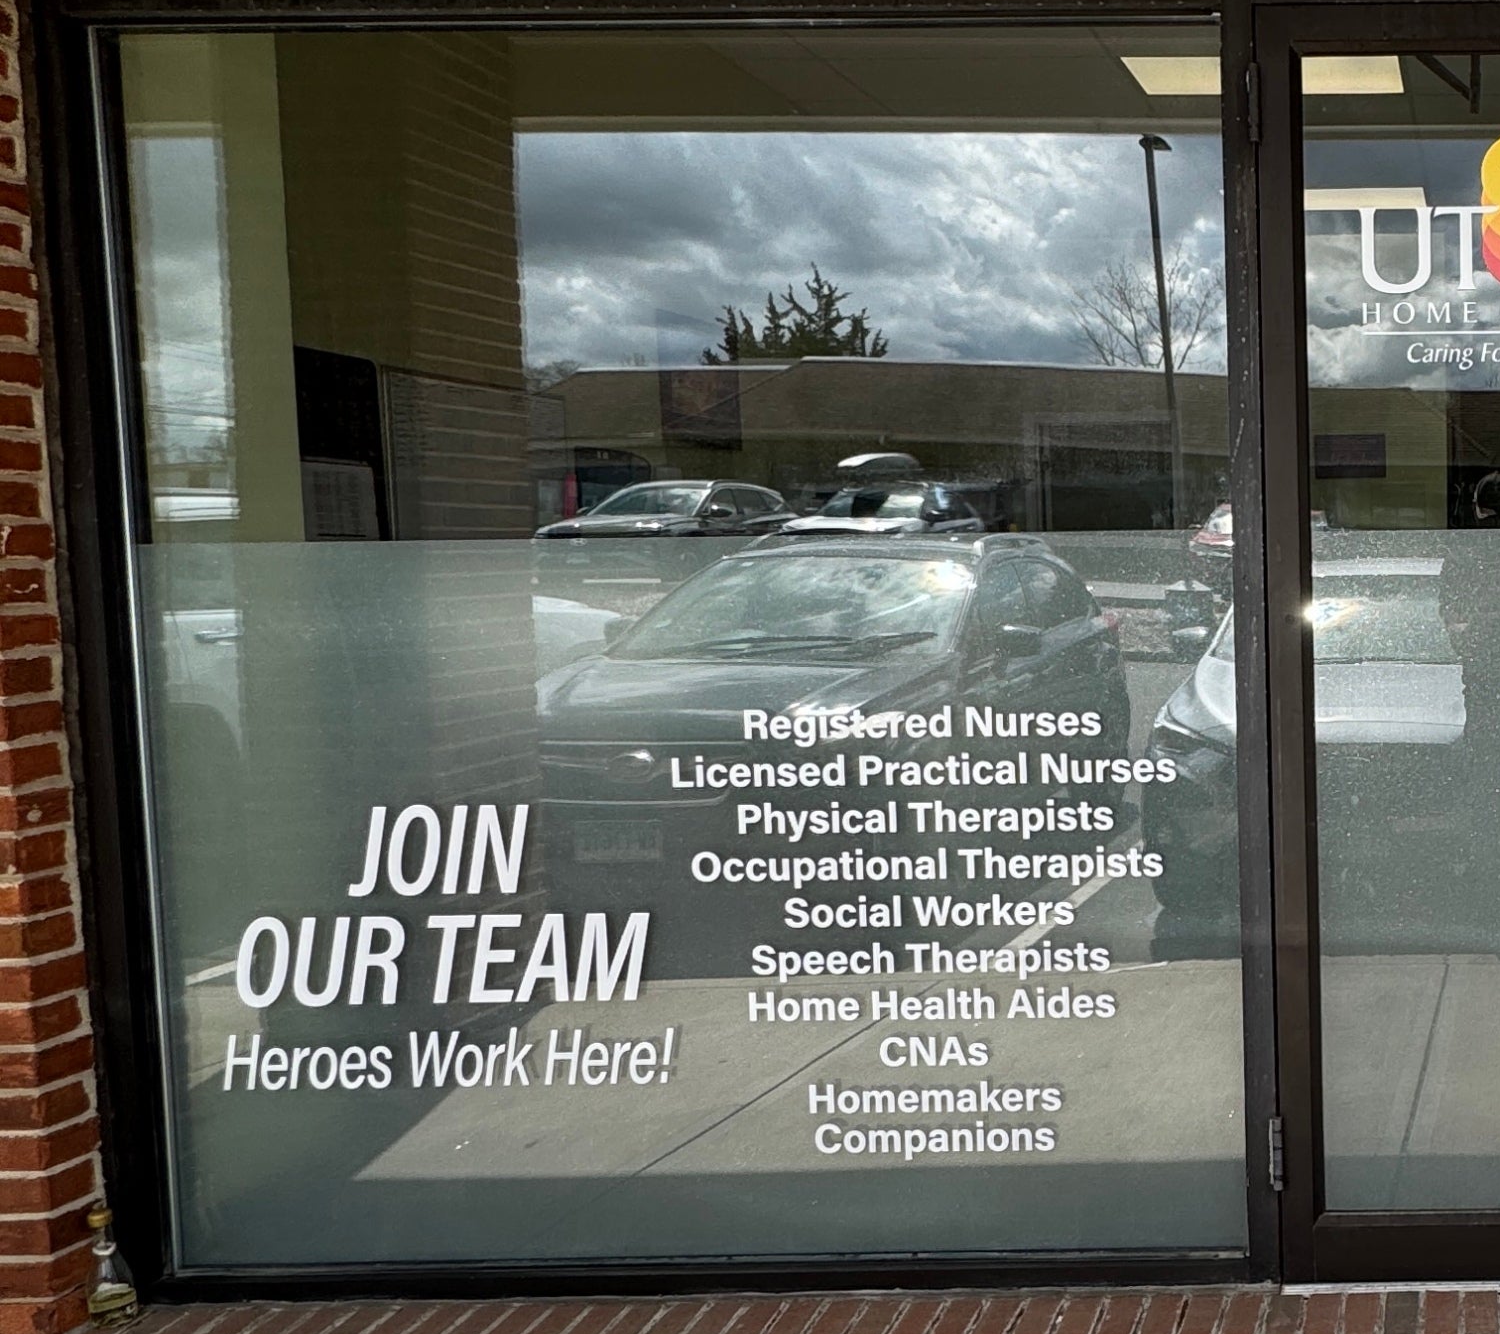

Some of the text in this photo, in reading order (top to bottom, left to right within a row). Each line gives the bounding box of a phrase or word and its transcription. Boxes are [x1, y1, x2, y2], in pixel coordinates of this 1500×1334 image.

[1361, 300, 1477, 325] HOME
[1407, 342, 1474, 370] Caring
[743, 704, 1102, 748] Registered Nurses
[671, 751, 1177, 788] Licensed Practical Nurses
[738, 799, 1114, 840] Physical Therapists
[348, 804, 529, 897] JOIN
[691, 845, 1163, 889] Occupational Therapists
[784, 893, 1075, 929] Social Workers
[235, 912, 650, 1009] OUR TEAM
[752, 939, 1116, 984] Speech Therapists
[748, 986, 1116, 1022] Home Health Aides
[223, 1026, 674, 1091] Heroes Work Here!
[879, 1036, 989, 1068] CNAs
[808, 1080, 1062, 1114] Homemakers
[814, 1120, 1055, 1161] Companions
